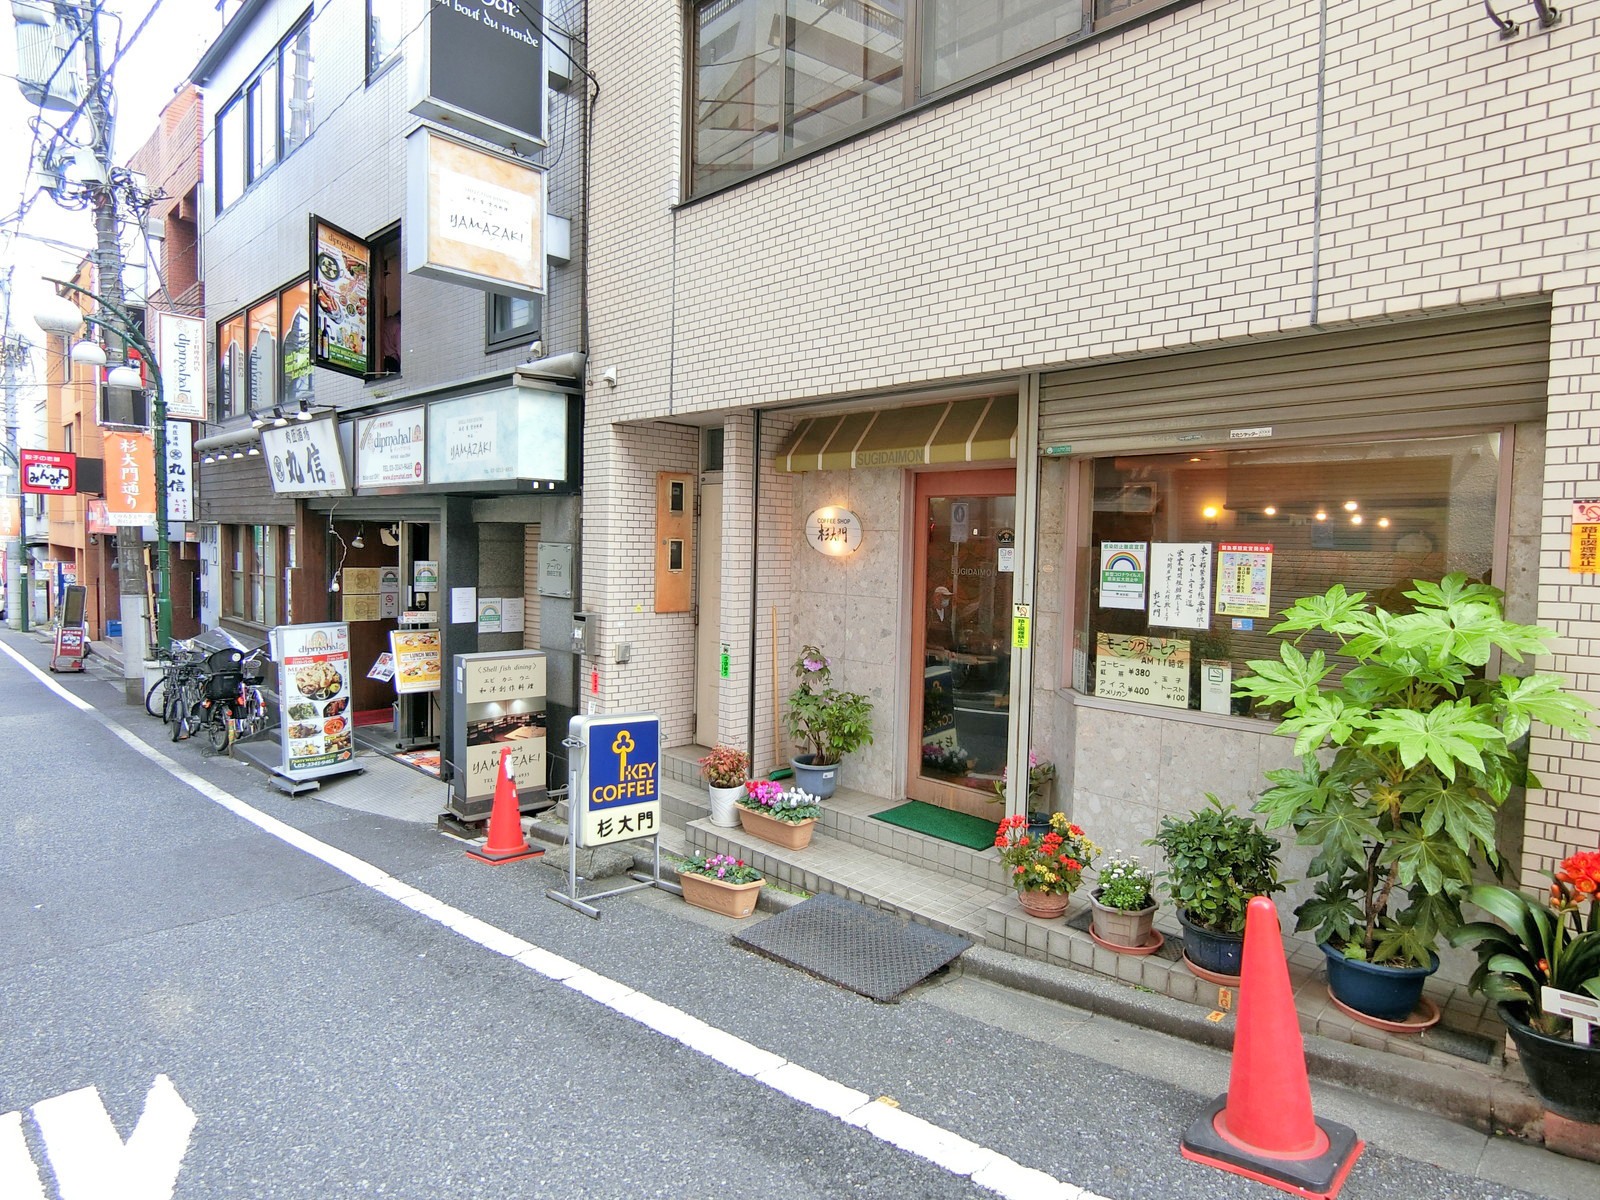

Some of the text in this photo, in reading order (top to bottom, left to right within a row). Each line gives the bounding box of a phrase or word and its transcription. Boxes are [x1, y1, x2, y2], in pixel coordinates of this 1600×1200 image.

[483, 9, 498, 29] du
[502, 24, 539, 47] monde
[450, 213, 524, 243] YAMAZAKI
[450, 441, 492, 460] YAMAZAKI
[857, 449, 924, 465] SUGIDAIMON
[286, 442, 327, 483] 丸信
[29, 469, 68, 484] みんみん
[120, 438, 140, 509] 杉大門通り
[167, 463, 186, 492] 丸信
[817, 524, 848, 543] 杉大門
[1107, 638, 1177, 656] モーニングサービス
[499, 664, 512, 673] fish
[1100, 660, 1125, 668] コーヒー
[1141, 656, 1153, 664] AM
[1128, 667, 1150, 677] ¥380
[1099, 688, 1128, 698] アメリカン
[1161, 685, 1184, 693] トースト
[1166, 693, 1186, 702] ¥100
[472, 753, 541, 775] YAMZAKI
[625, 762, 656, 780] KEY
[592, 779, 655, 803] COFFEE
[597, 811, 653, 838] 杉大門
